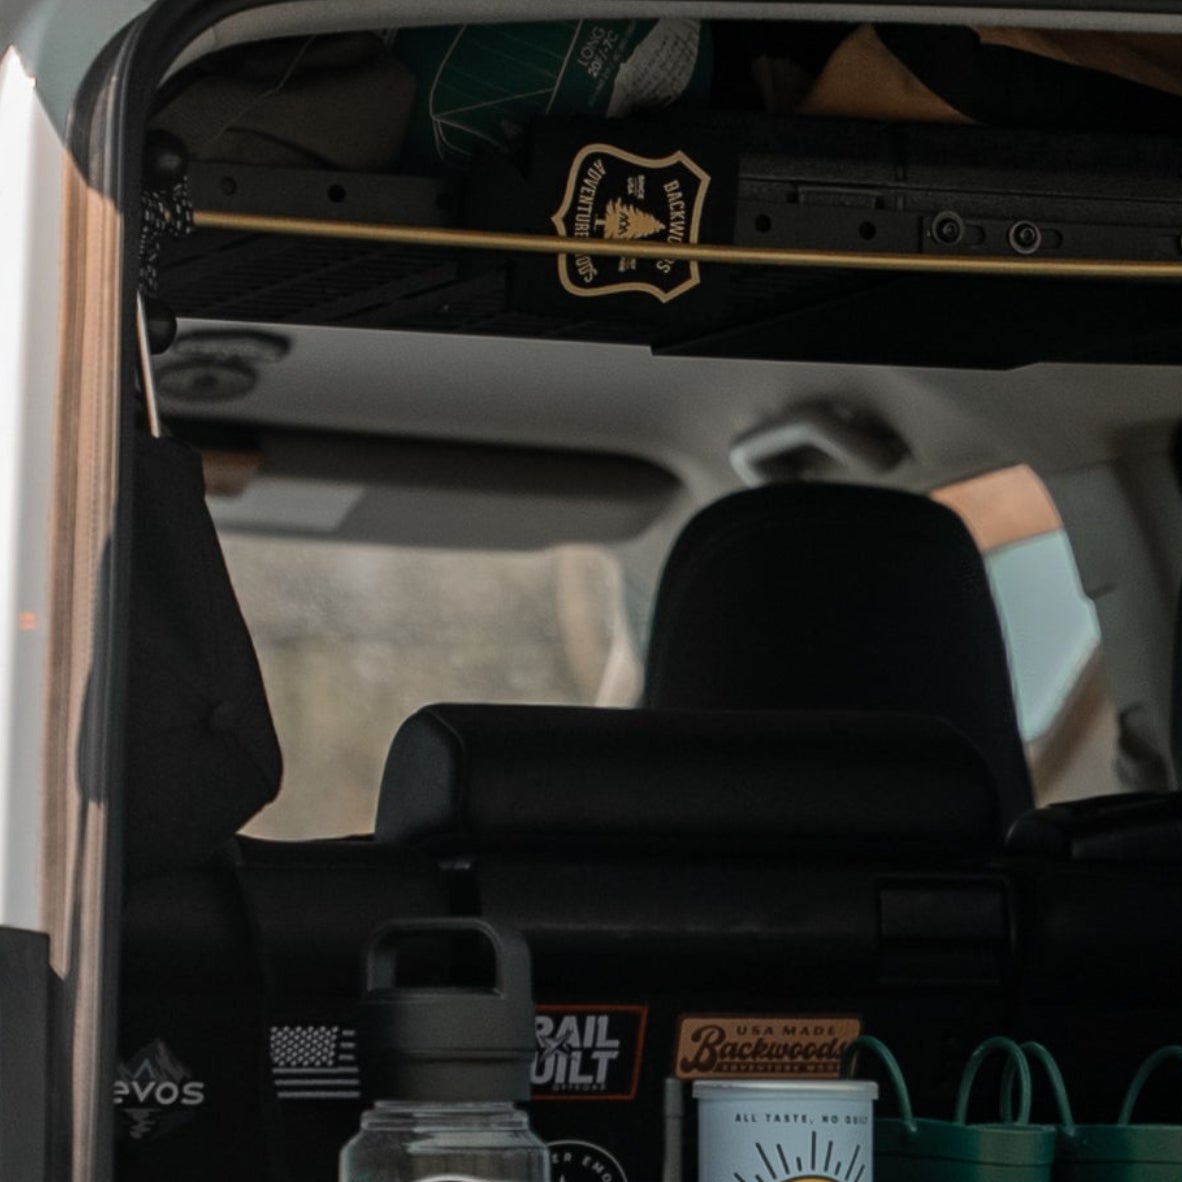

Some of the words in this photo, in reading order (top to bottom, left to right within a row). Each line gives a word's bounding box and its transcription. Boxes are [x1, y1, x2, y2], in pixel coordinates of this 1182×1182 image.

[578, 27, 605, 66] LONG
[574, 160, 606, 238] ADVENTURE
[656, 180, 686, 273] BACKWS
[534, 1015, 620, 1049] RAIL
[737, 1025, 774, 1036] USA
[531, 1050, 619, 1084] UILT
[735, 1114, 757, 1123] ALL
[821, 1114, 839, 1125] NO
